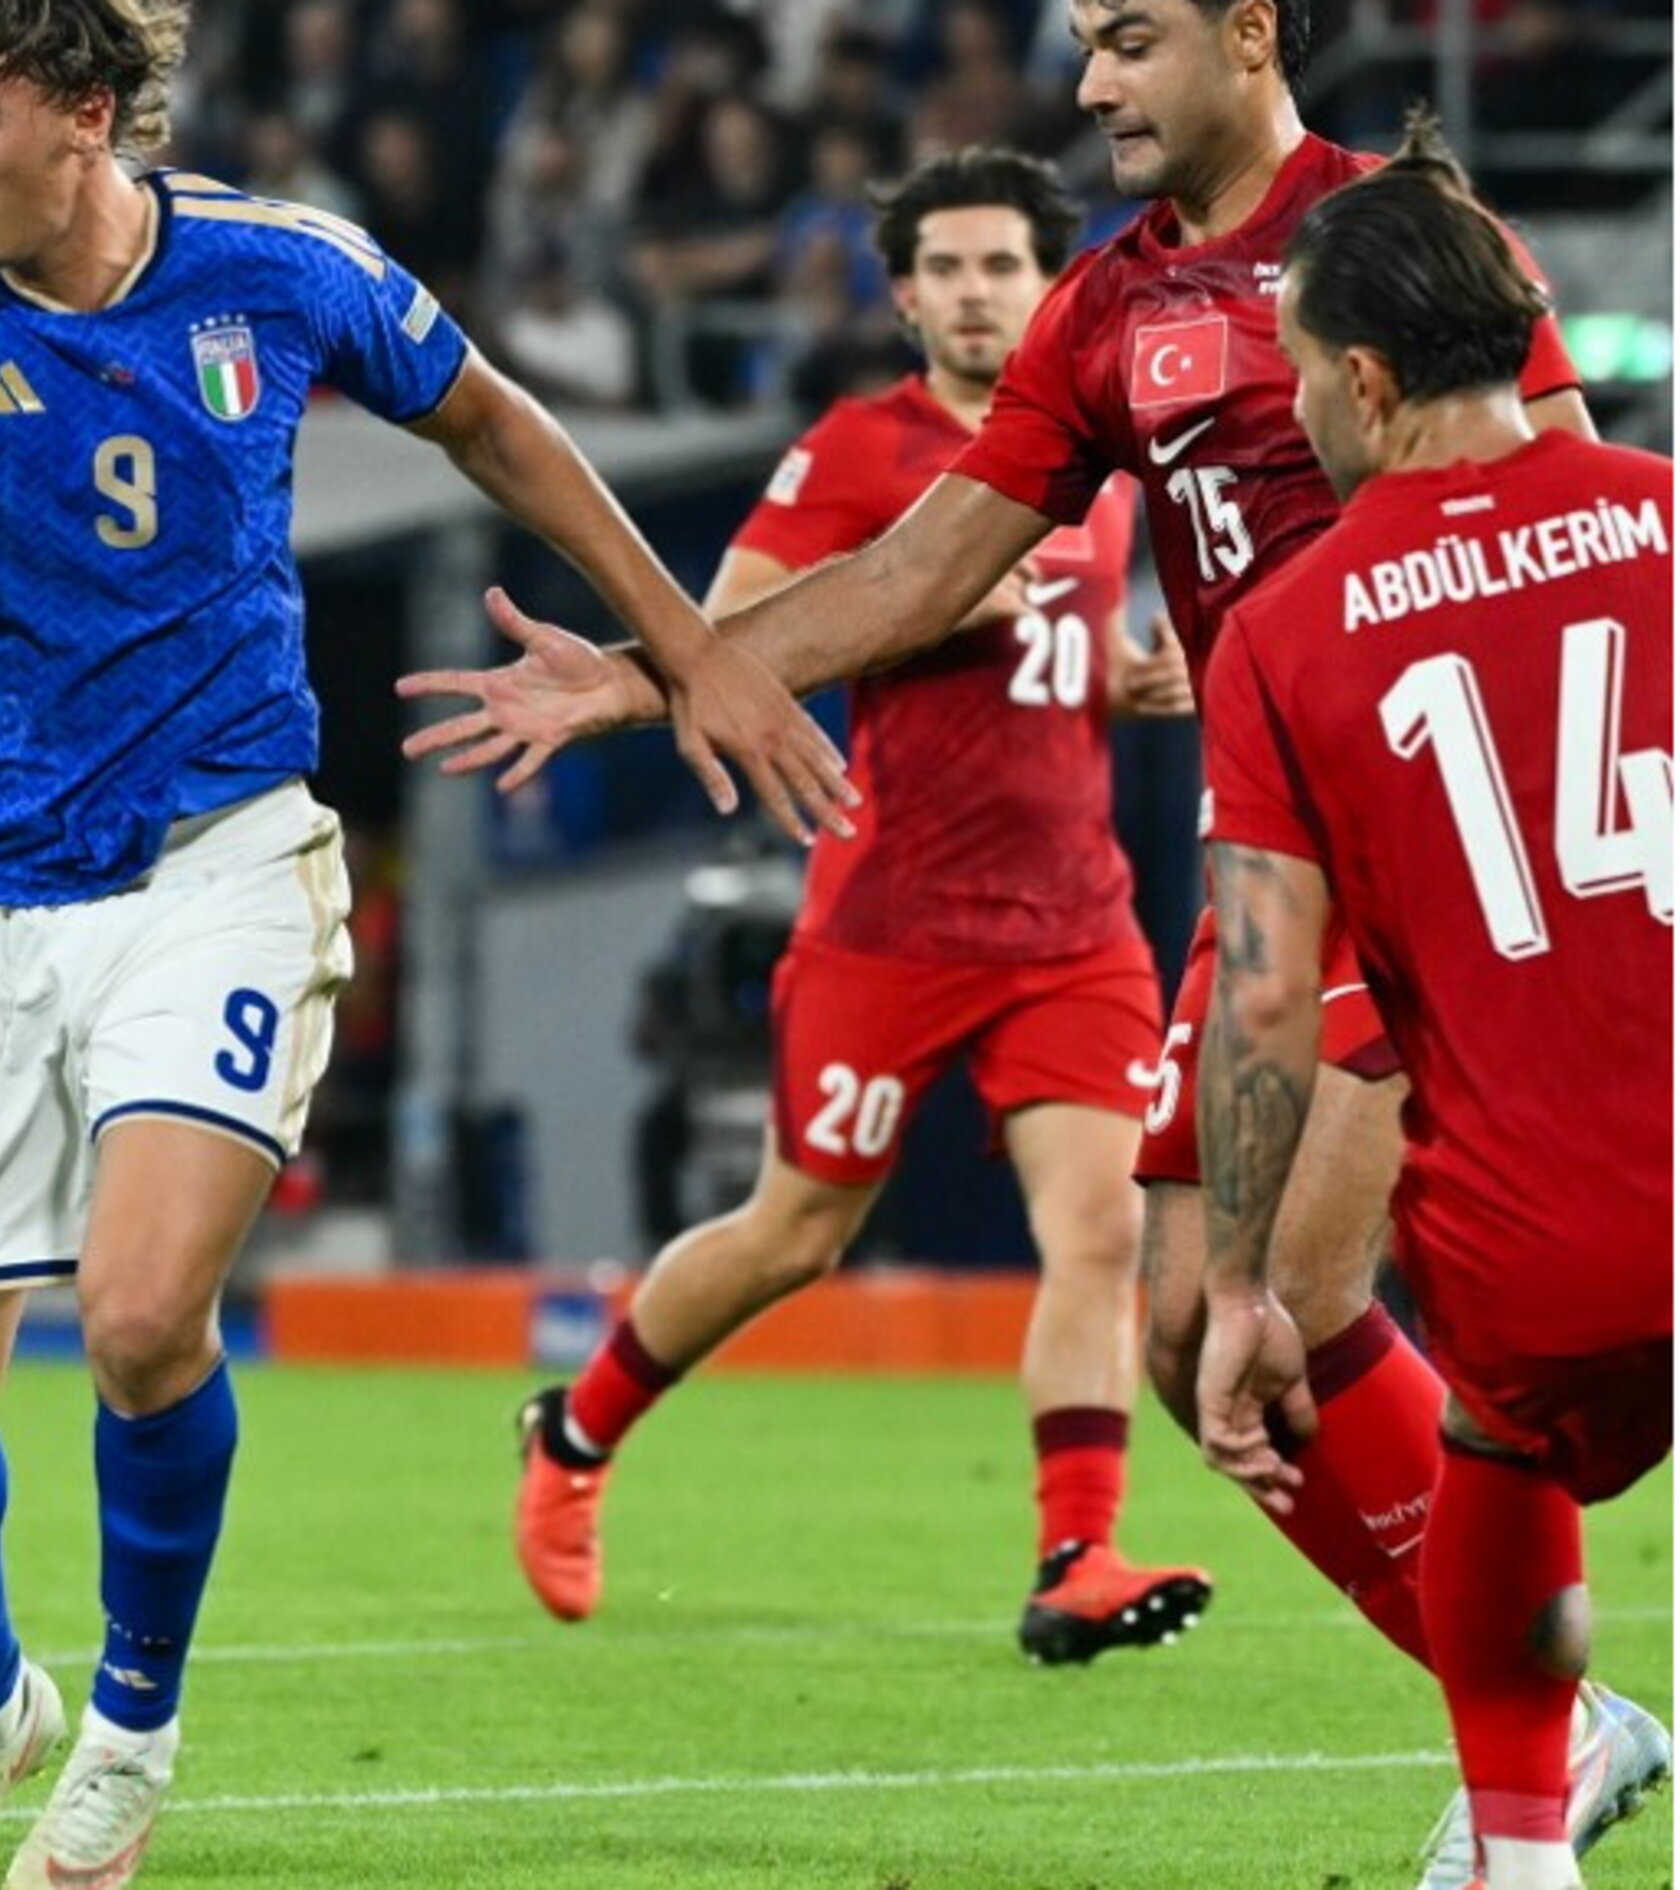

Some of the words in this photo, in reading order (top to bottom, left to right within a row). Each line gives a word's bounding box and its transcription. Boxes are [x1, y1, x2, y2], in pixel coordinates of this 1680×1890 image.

[93, 434, 158, 549] 9
[1165, 466, 1254, 581] 15
[1344, 496, 1670, 633] ABDÜLKERİM
[1008, 612, 1090, 708] 20
[1378, 617, 1673, 961] 14
[215, 987, 280, 1093] 9
[805, 1062, 906, 1158] 20
